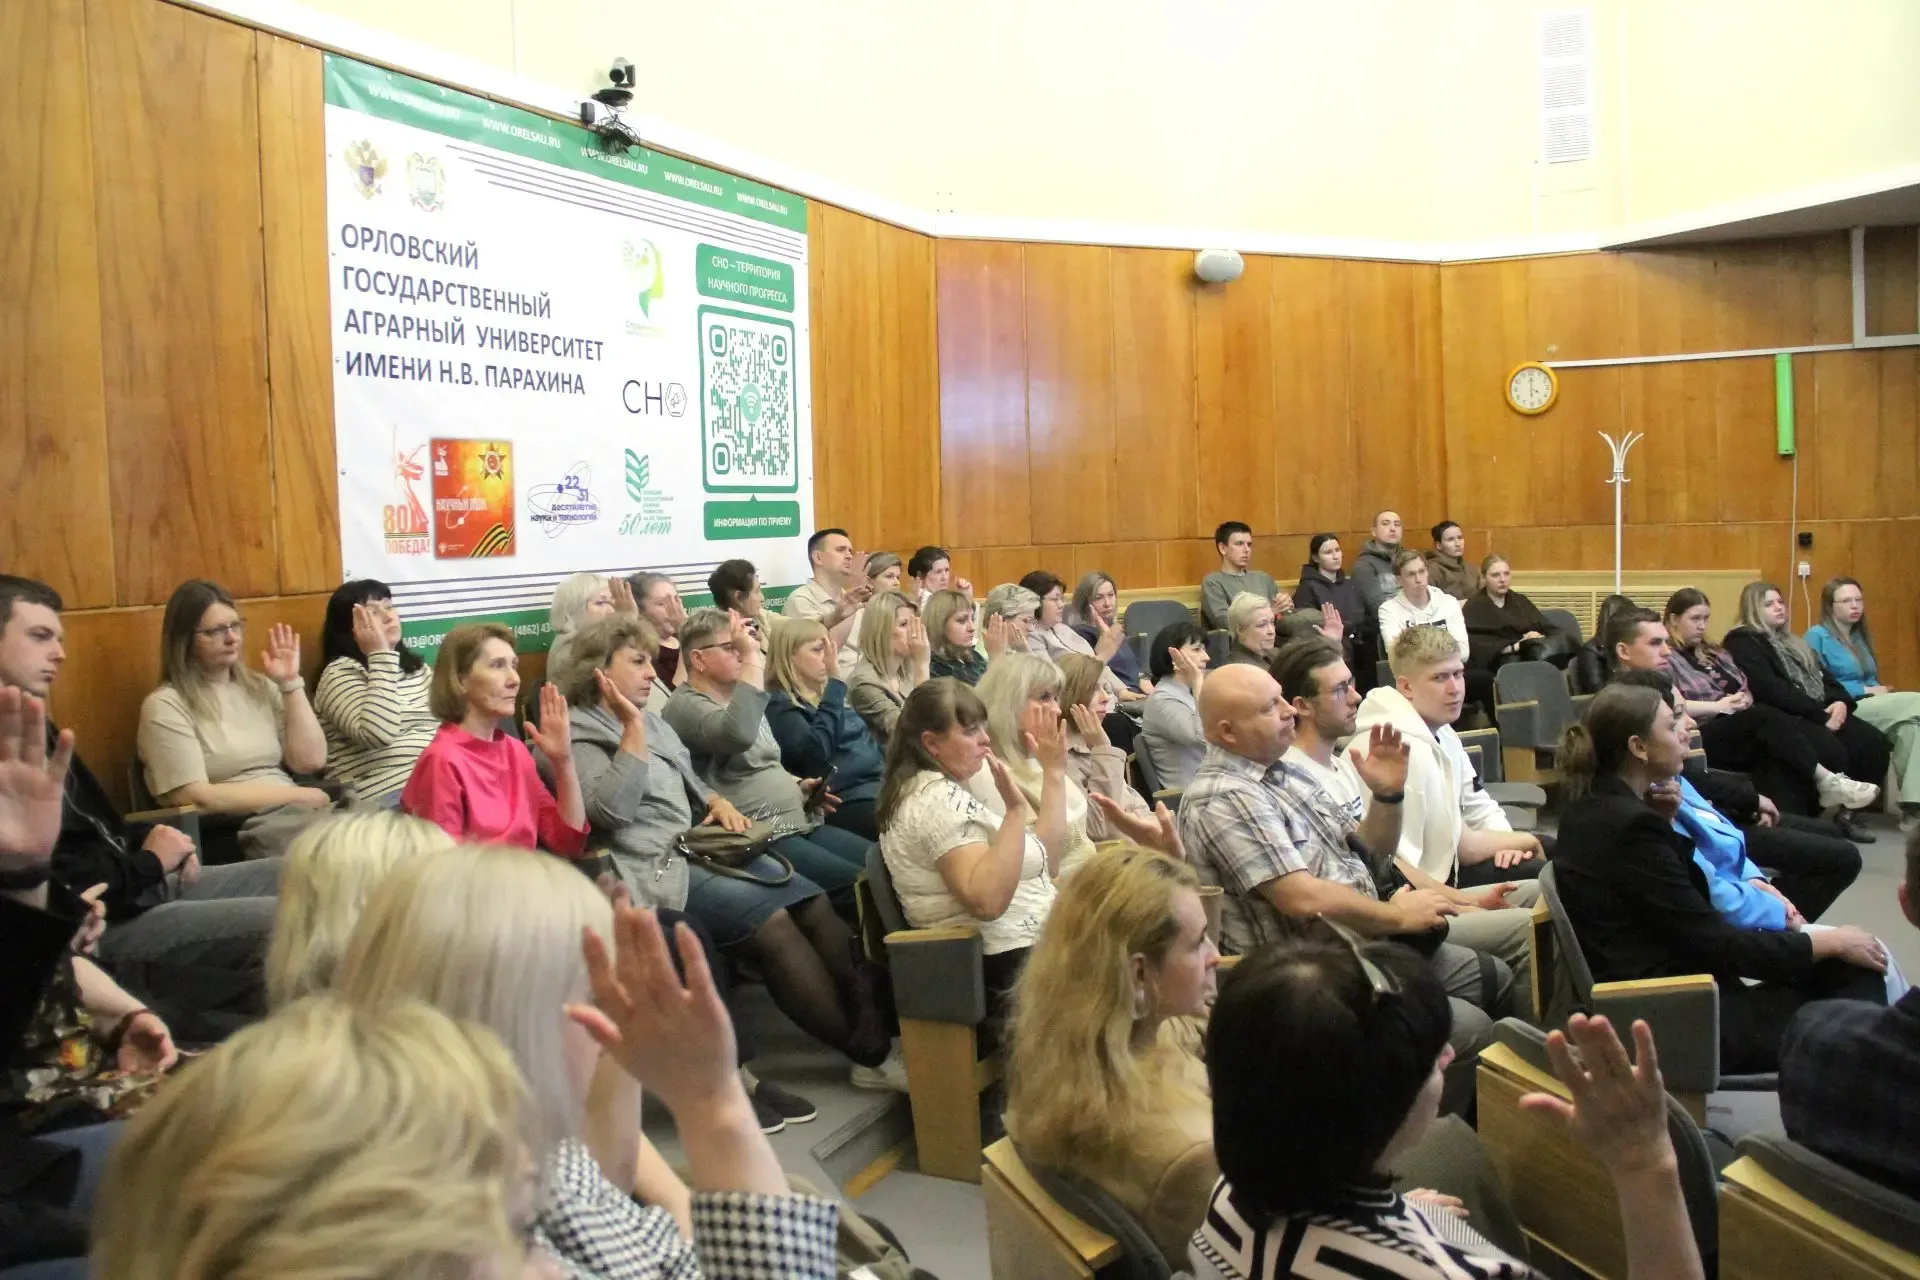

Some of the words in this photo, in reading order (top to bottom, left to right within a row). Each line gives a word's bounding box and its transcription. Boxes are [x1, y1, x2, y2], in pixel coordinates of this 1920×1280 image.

[368, 84, 461, 120] WWW..RU
[481, 116, 561, 149] WWW.ORELSAU.RU
[664, 170, 723, 196] WWW.ORELSAU.RU
[736, 192, 788, 216] WWW.ORELSAU.RU
[341, 223, 478, 270] ОРЛОВСКИЙ
[712, 255, 729, 270] СНО
[736, 261, 781, 281] ТЕРРИТОРИЯ
[343, 265, 551, 319] ГОСУДАРСТВЕННЫЙ
[708, 277, 748, 296] НАУЧНОГО
[749, 285, 787, 304] ПРОГРЕССА
[344, 308, 465, 346] АГРАРНЫЙ
[476, 325, 604, 362] УНИВЕРСИТЕТ
[346, 350, 432, 382] ИМЕНИ
[439, 360, 479, 386] Н.В.
[485, 365, 586, 395] ПАРАХИНА
[565, 475, 580, 489] 22
[578, 488, 589, 501] 31
[383, 504, 411, 533] 80
[618, 512, 642, 536] 50
[713, 517, 757, 528] ИНФОРМАЦИЯ
[758, 517, 768, 526] ПО
[768, 516, 792, 526] ПРИЕМУ
[384, 538, 431, 555] ПОБЕДА!
[514, 623, 540, 638] (4862)
